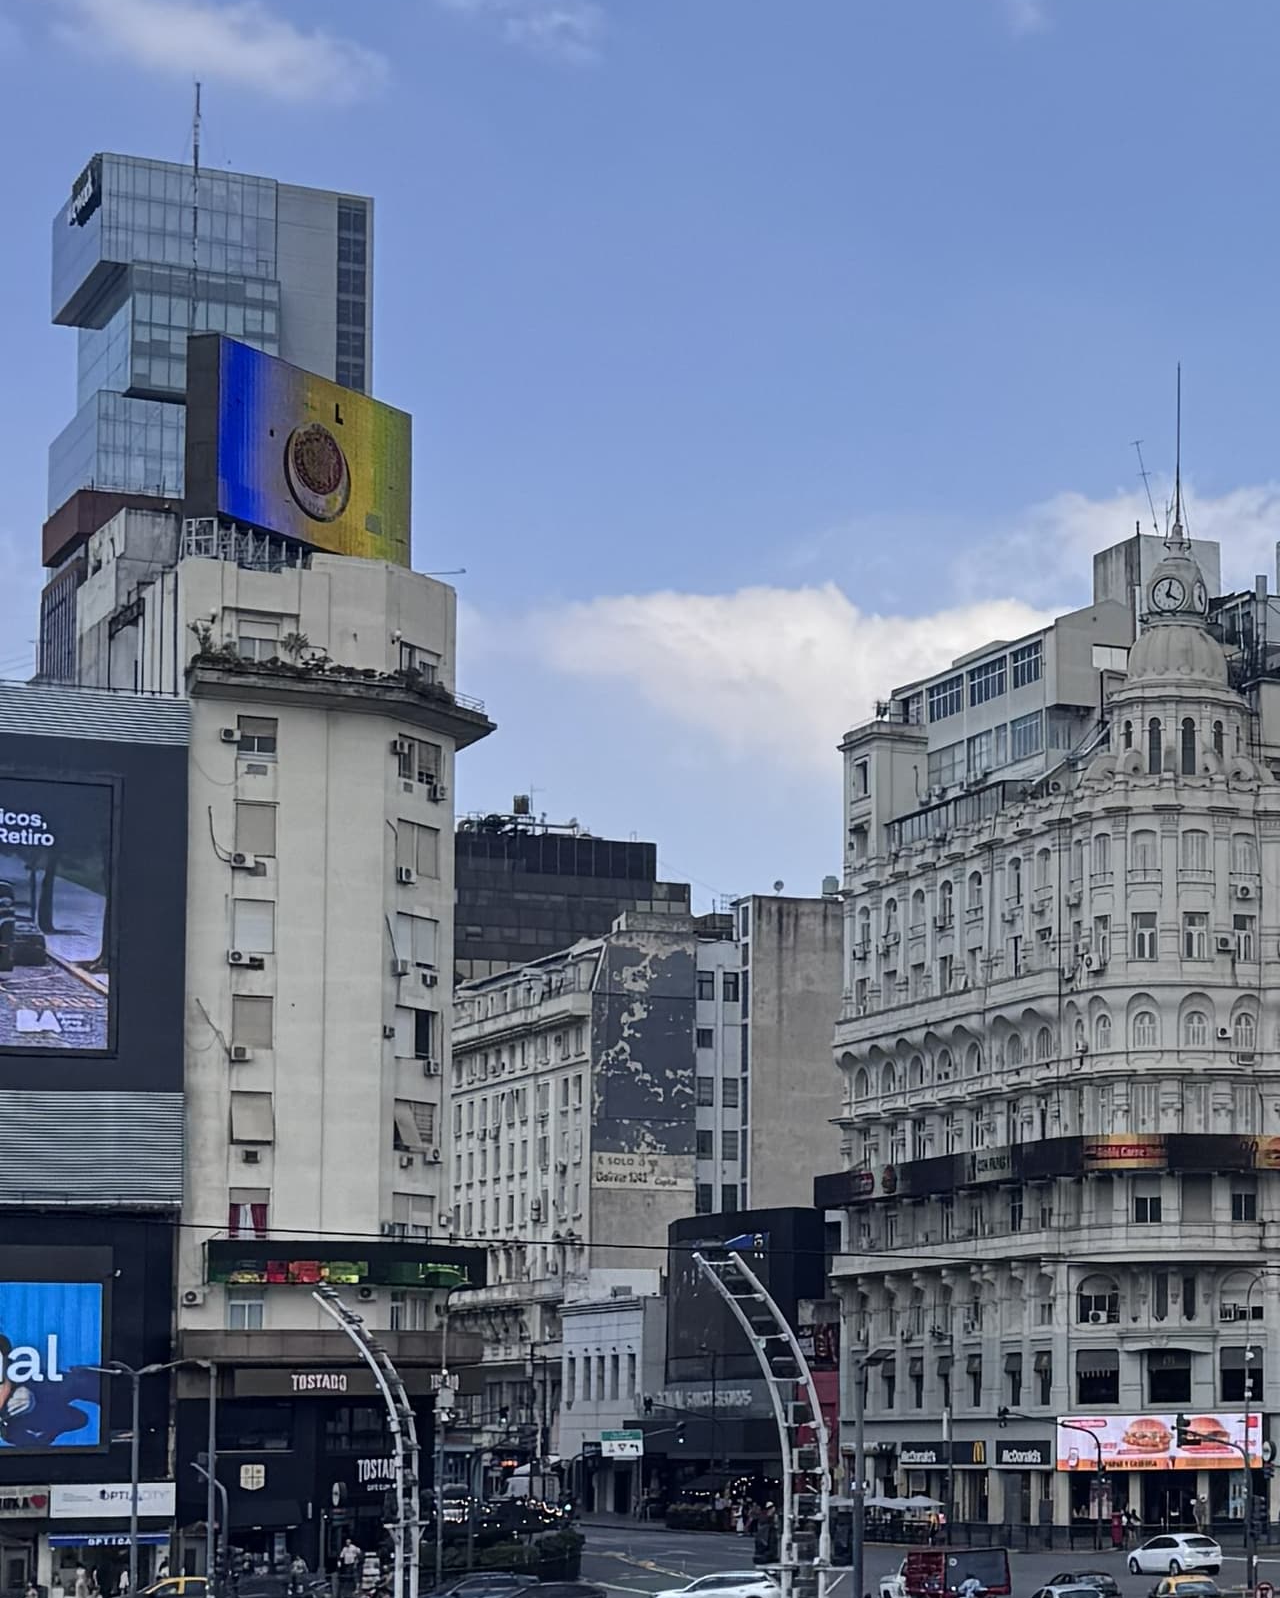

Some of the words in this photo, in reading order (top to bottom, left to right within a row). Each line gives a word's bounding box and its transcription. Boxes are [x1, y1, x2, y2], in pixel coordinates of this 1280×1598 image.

[0, 1335, 63, 1383] al
[291, 1374, 347, 1392] TOSTADO
[1001, 1449, 1041, 1463] McDonald's
[357, 1458, 397, 1483] TOSTAD
